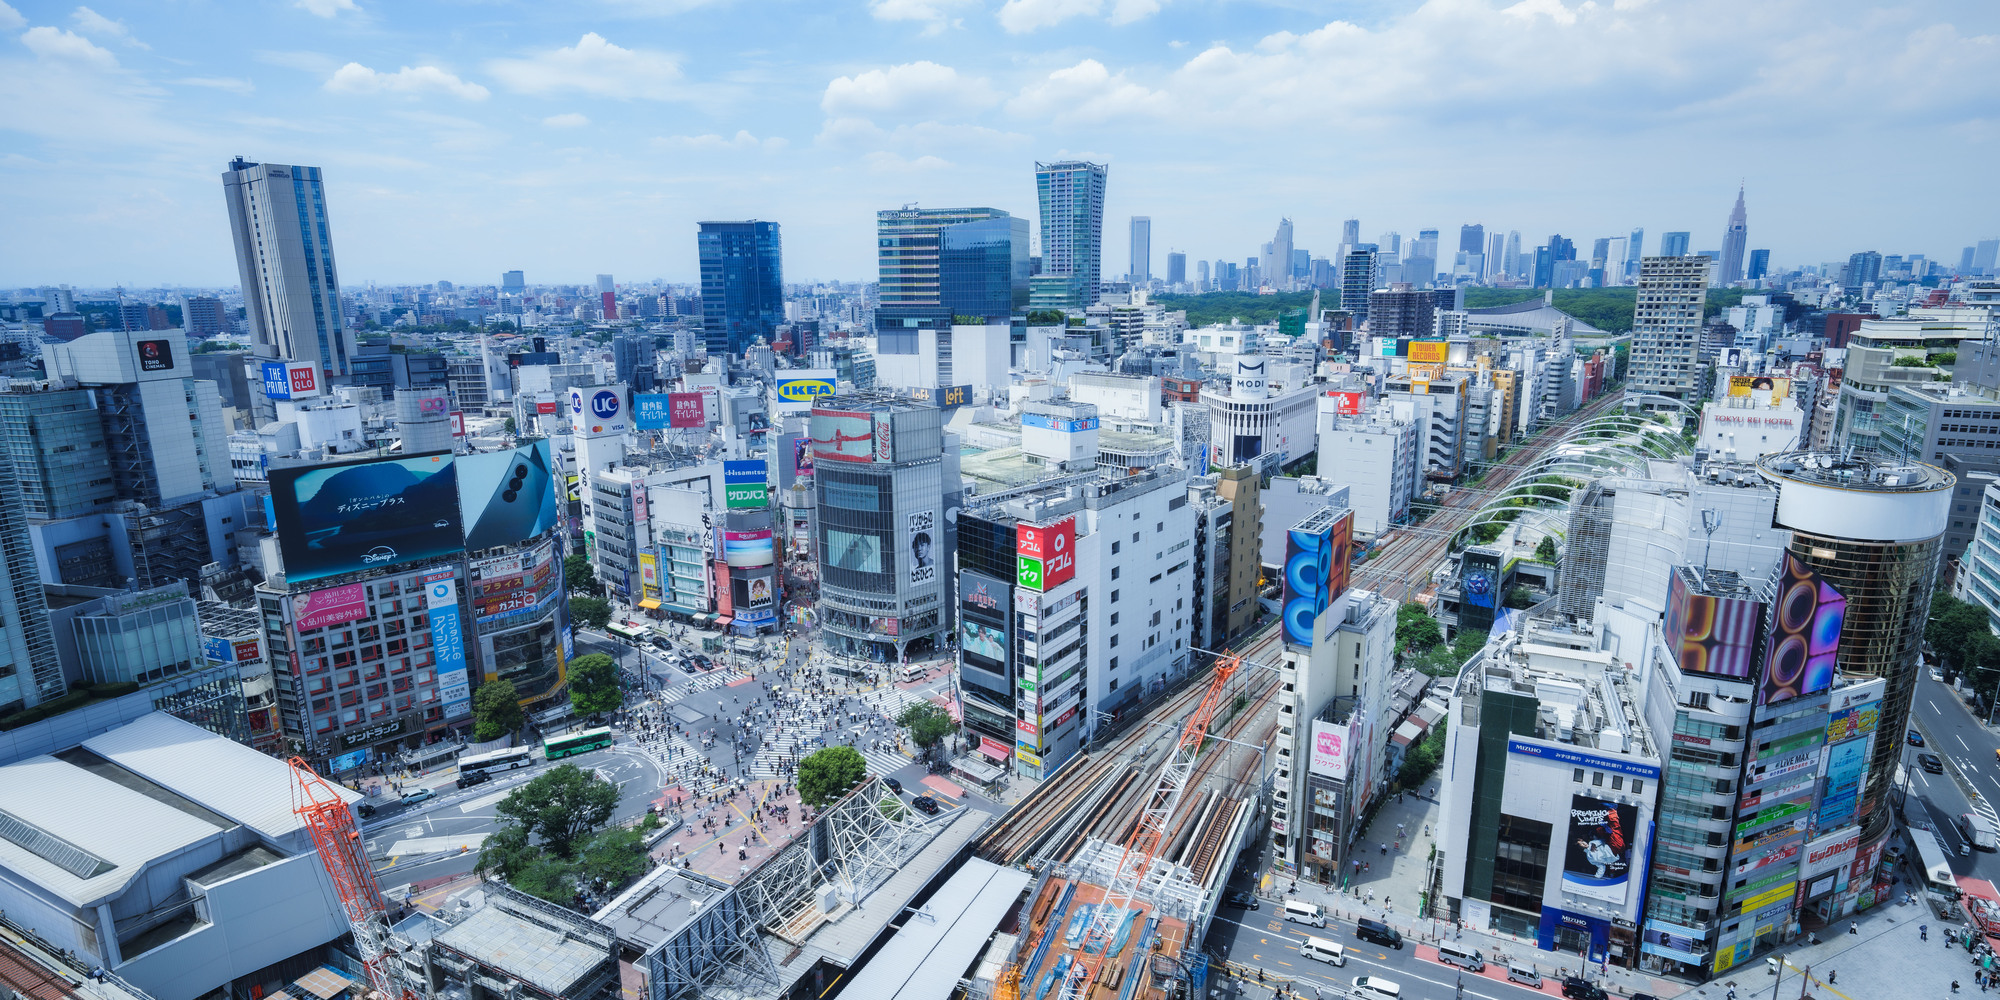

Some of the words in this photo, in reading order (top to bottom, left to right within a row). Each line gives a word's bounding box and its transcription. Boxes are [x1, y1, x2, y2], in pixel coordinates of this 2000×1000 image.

[1415, 343, 1436, 352] TOWER
[1412, 352, 1440, 361] RECORDS
[267, 367, 282, 377] THE
[292, 370, 310, 380] UNI
[266, 380, 288, 395] PRIME
[294, 379, 313, 391] QLO
[1237, 380, 1264, 388] MODI
[783, 385, 831, 396] IKEA
[417, 396, 446, 417] 109
[593, 396, 618, 412] UC
[1714, 415, 1745, 423] TOKYU
[1747, 416, 1761, 424] REI
[1764, 418, 1794, 426] HOTEL
[611, 424, 625, 432] VISA
[727, 489, 766, 501] サロンパス
[336, 496, 405, 514] ディズニープラス
[1020, 540, 1041, 553] アコム
[1045, 552, 1073, 577] アコム
[499, 600, 523, 612] ガスト
[750, 596, 772, 608] DMM
[306, 607, 364, 627] 品川美容外科
[433, 614, 450, 663] アイシティ
[447, 613, 462, 661] コンタクトの
[1020, 678, 1034, 689] レイク
[1019, 721, 1035, 732] アコム
[346, 721, 400, 745] サンドラッグ
[1515, 744, 1542, 754] MIZUHO
[1314, 758, 1342, 770] ワクワク
[1555, 752, 1582, 762] みずほ銀行
[1625, 765, 1653, 775] みずほ証券
[1794, 752, 1811, 764] MAX
[1808, 836, 1860, 864] ビックカメラ
[1767, 852, 1786, 864] アコム
[1561, 914, 1587, 926] MIZUHO
